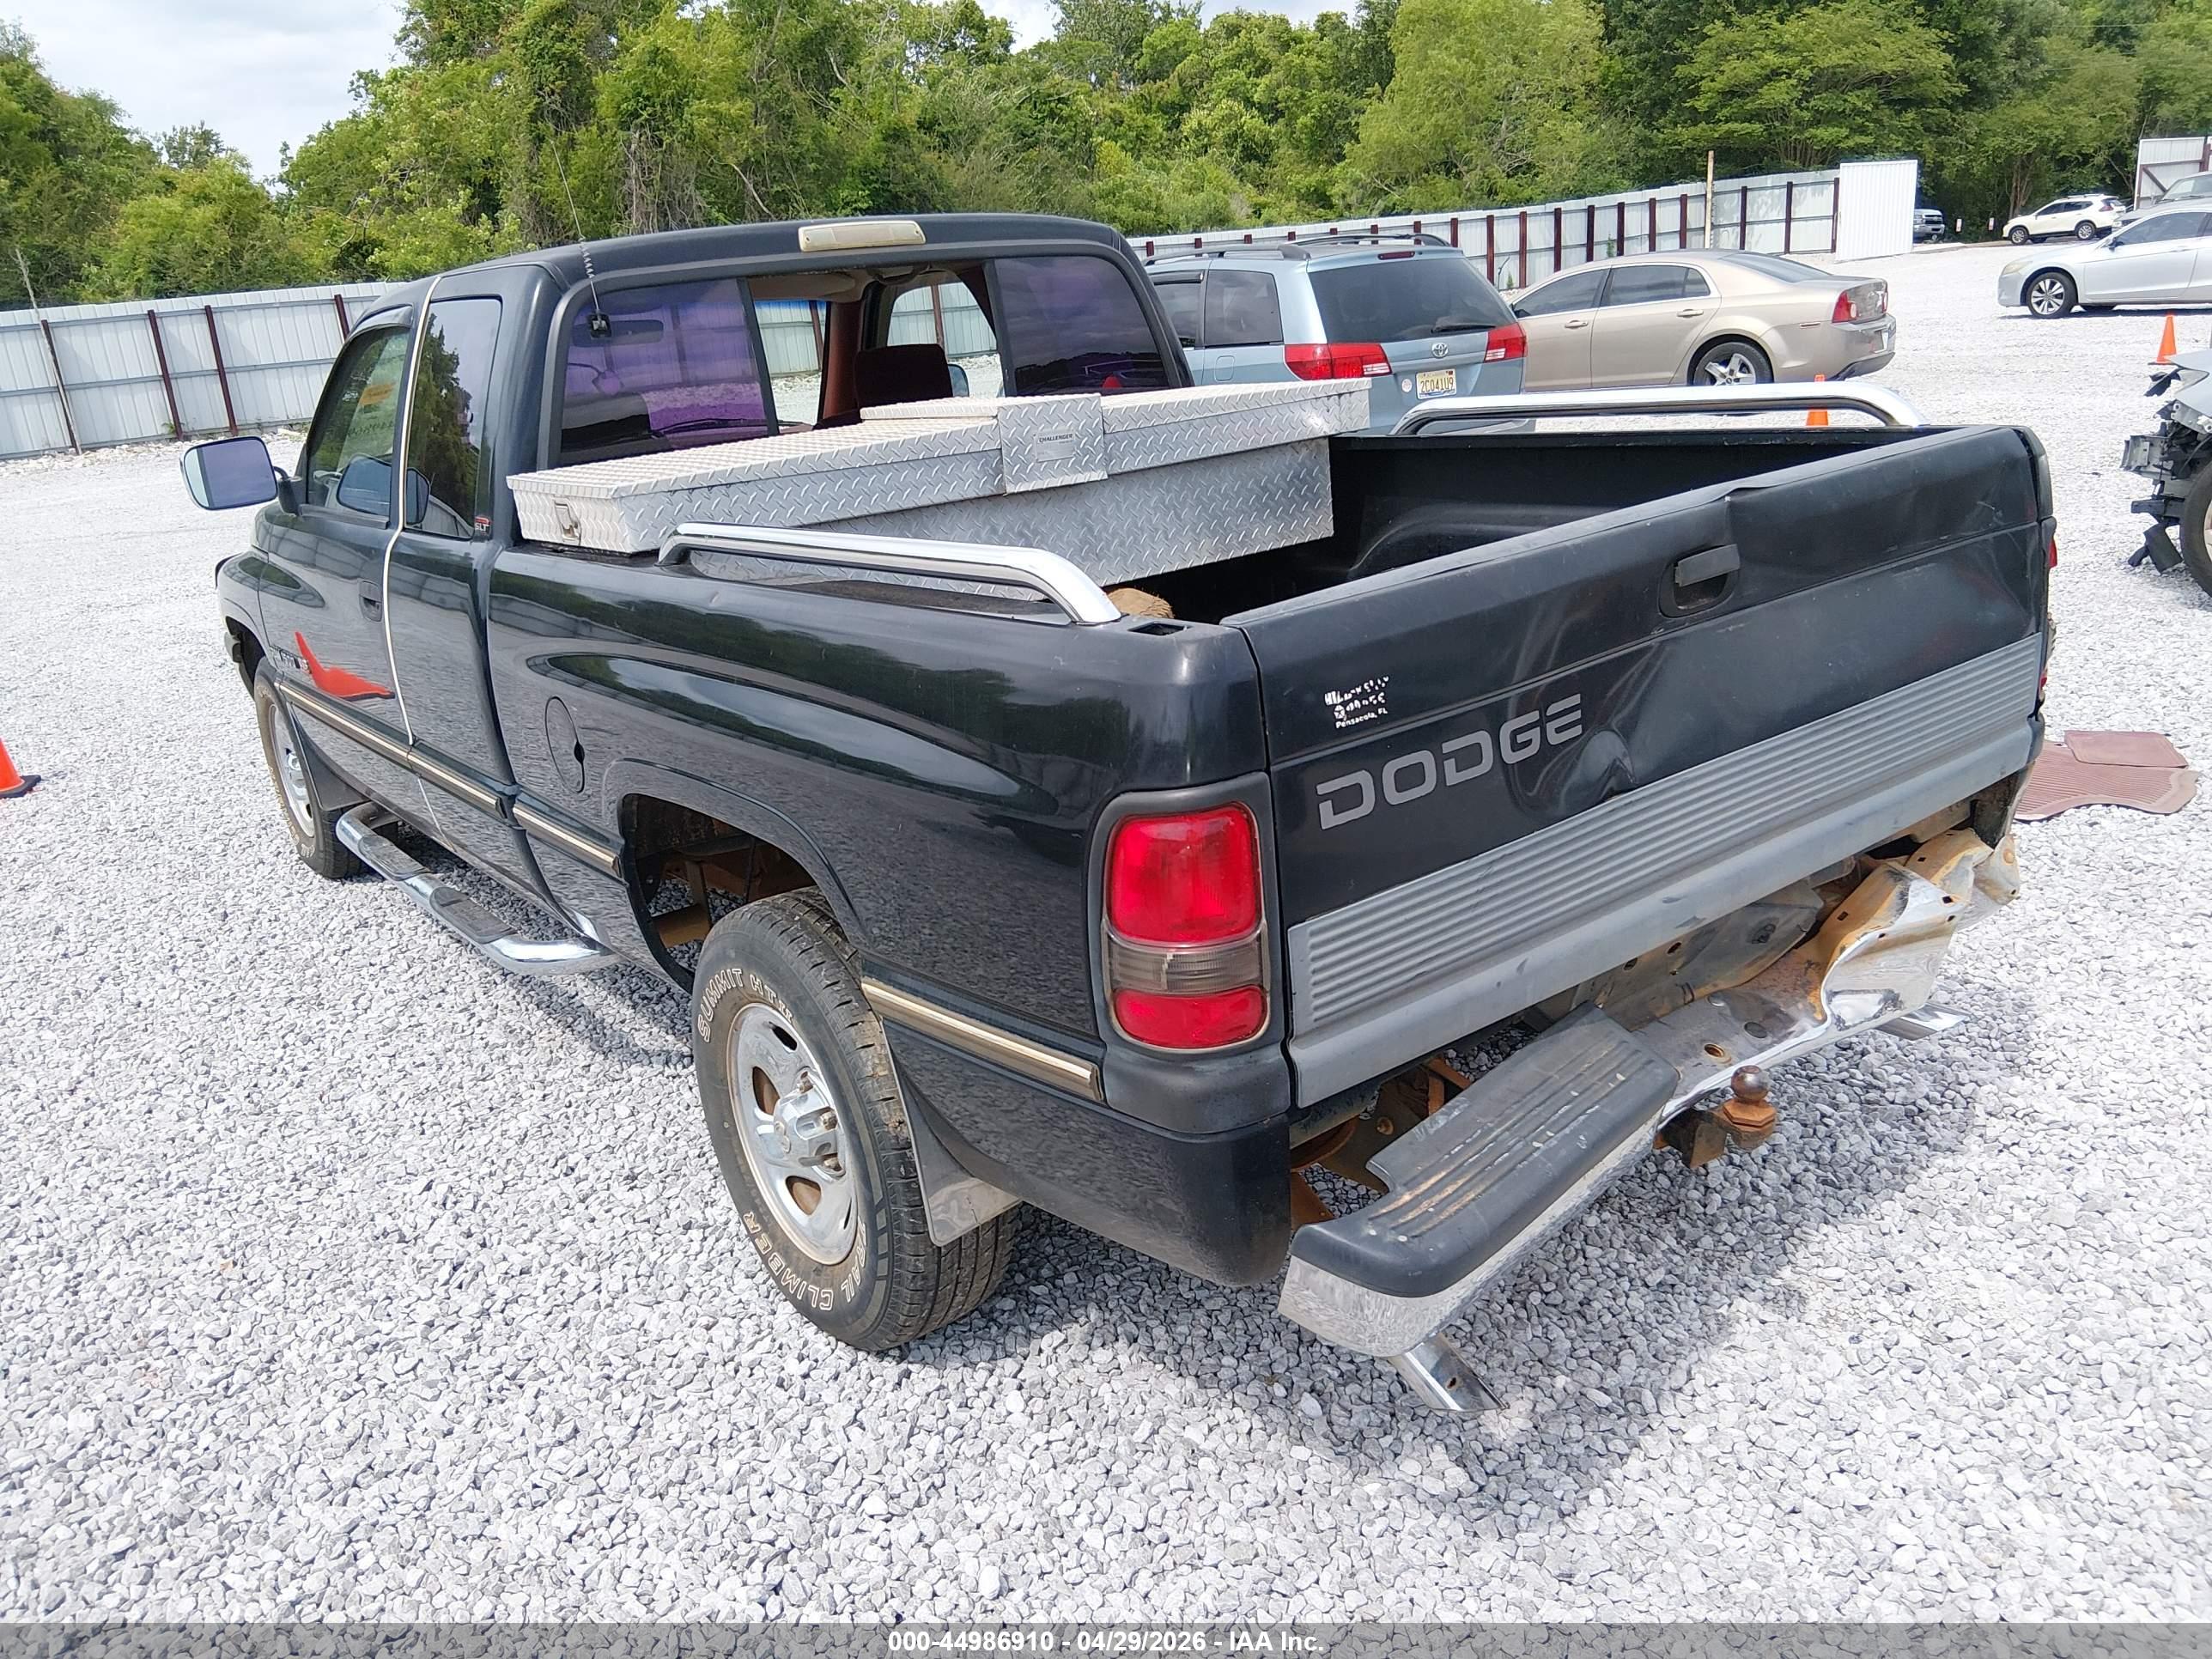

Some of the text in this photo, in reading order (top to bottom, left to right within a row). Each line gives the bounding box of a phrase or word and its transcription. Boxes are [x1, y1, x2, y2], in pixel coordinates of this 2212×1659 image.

[1039, 433, 1073, 442] CHALLENGER
[474, 522, 489, 532] SLT
[1316, 693, 1583, 830] DODGE
[697, 968, 744, 1043] SUMMIT
[743, 1211, 867, 1311] TRAIL CLIMBER
